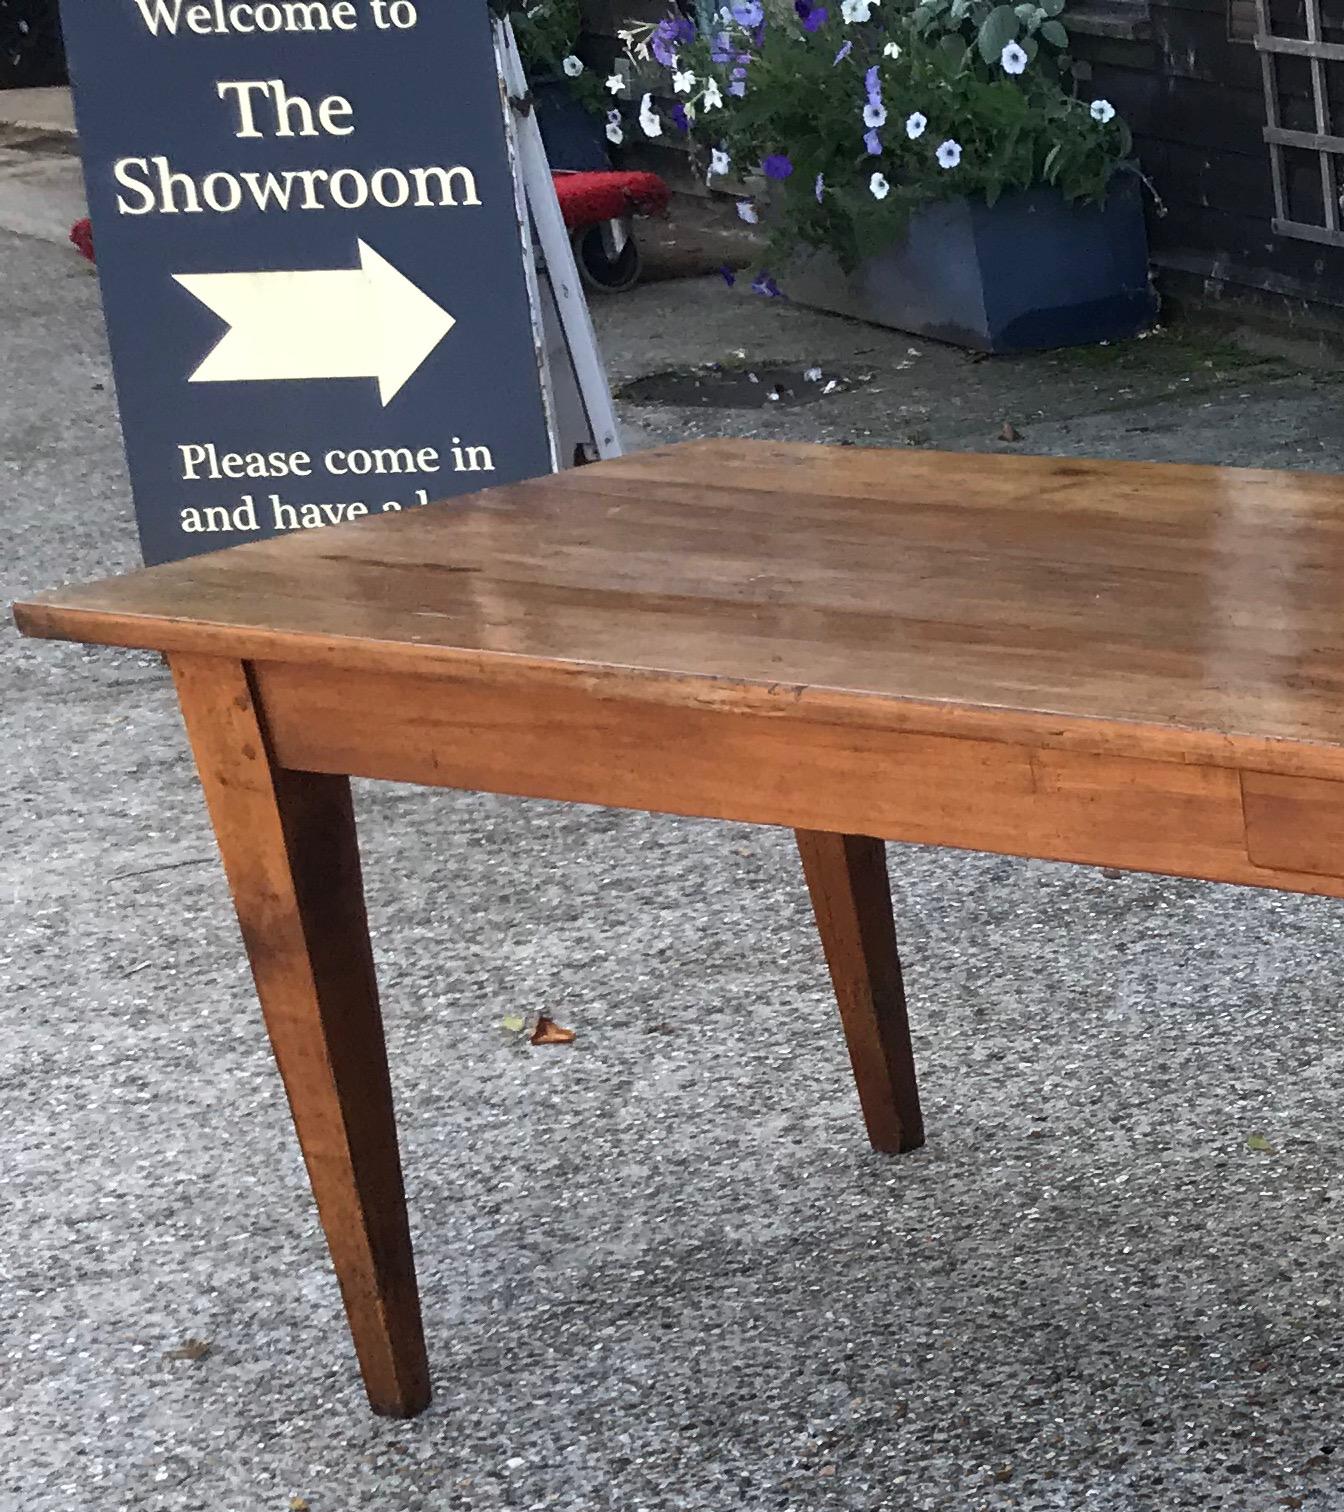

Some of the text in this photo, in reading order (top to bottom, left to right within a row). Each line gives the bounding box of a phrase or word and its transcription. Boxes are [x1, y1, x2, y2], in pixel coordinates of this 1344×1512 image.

[134, 0, 417, 36] Welcome to
[216, 79, 355, 138] The
[113, 156, 482, 215] Showroom
[177, 437, 496, 480] Please come in
[181, 496, 260, 533] and
[268, 495, 369, 530] have
